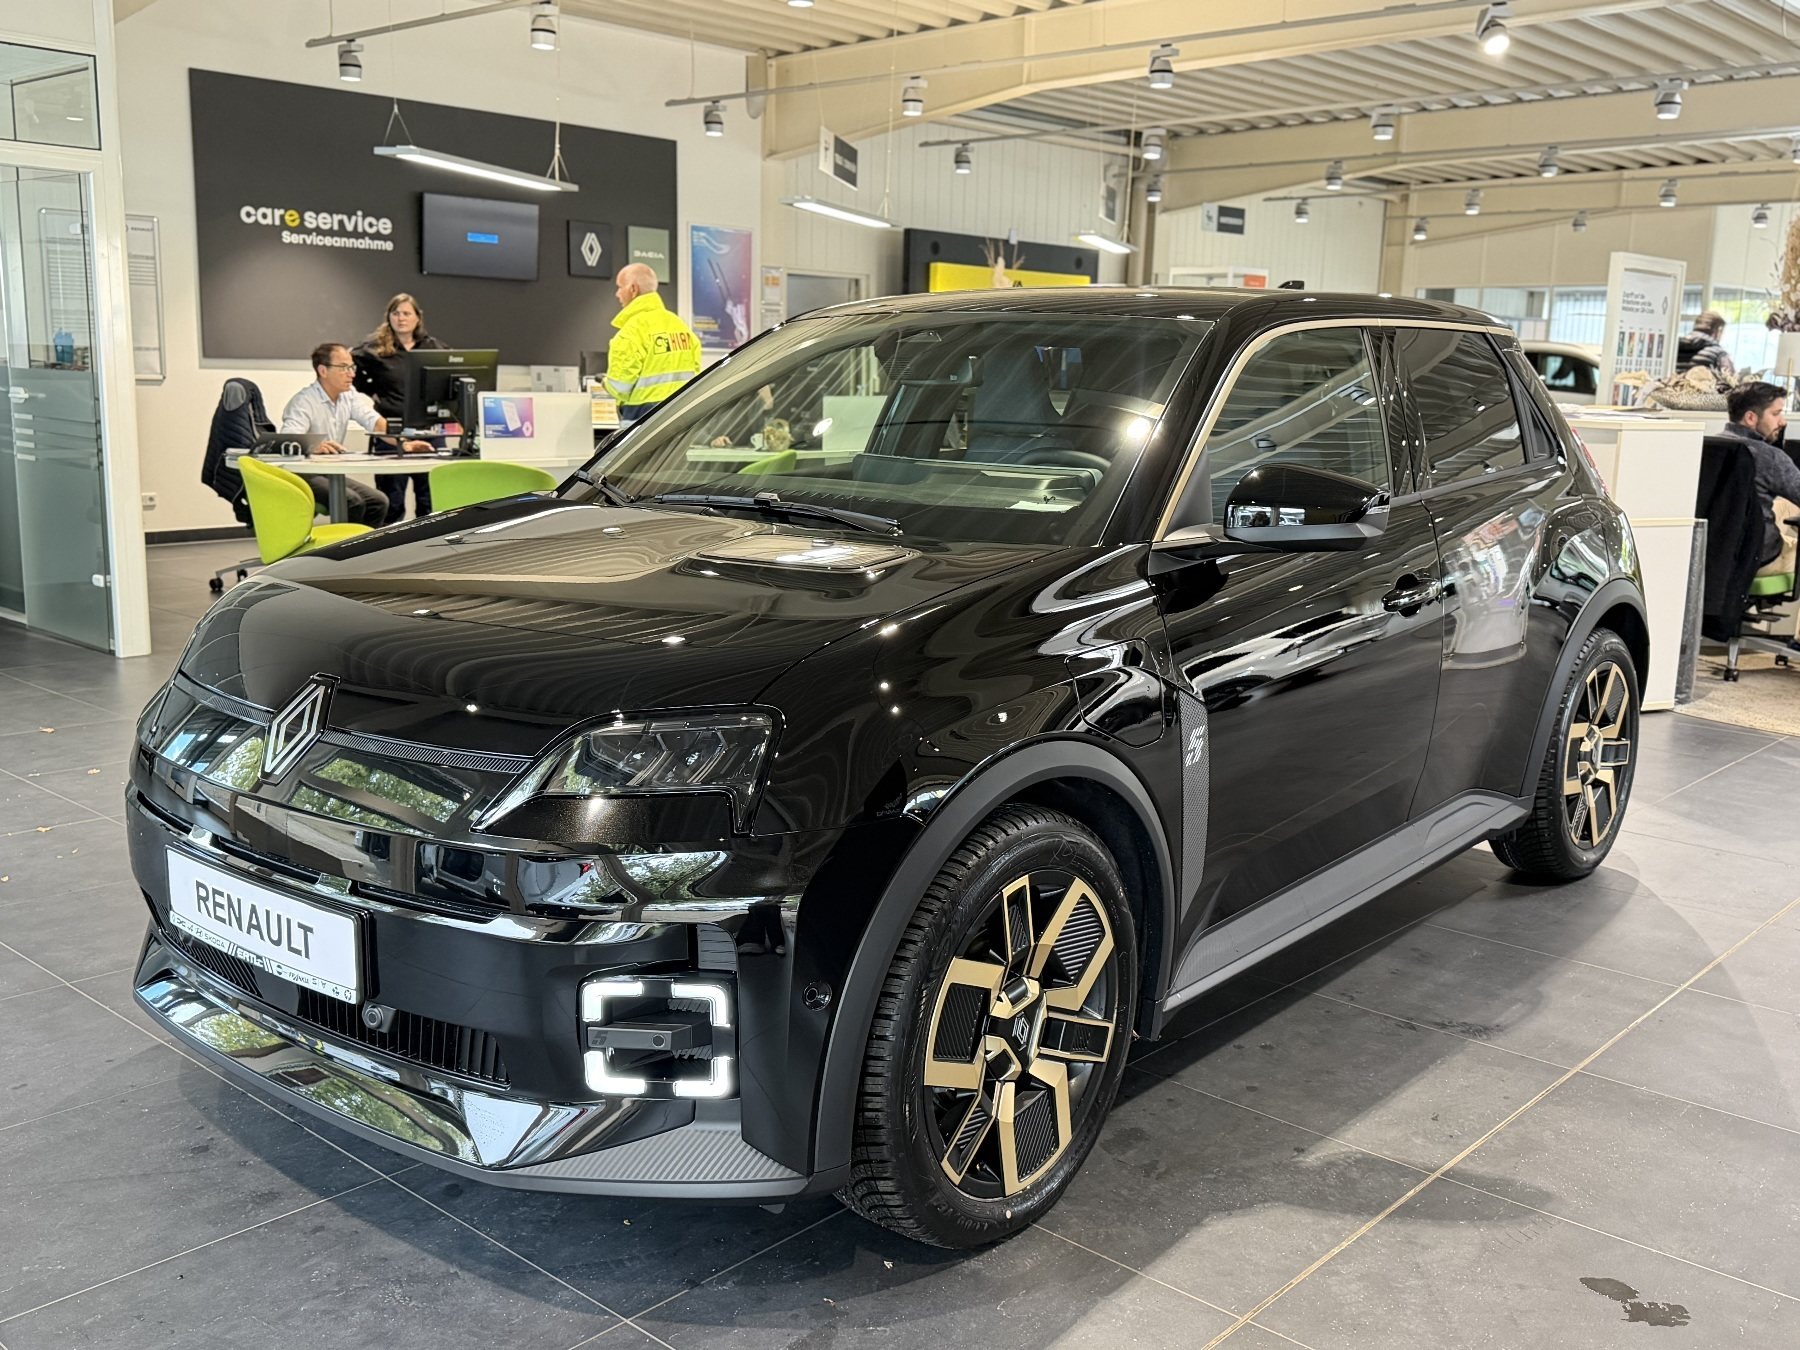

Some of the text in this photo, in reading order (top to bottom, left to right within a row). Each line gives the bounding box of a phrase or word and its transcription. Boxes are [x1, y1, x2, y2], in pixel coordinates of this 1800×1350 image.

[240, 205, 392, 235] care service
[281, 230, 394, 251] Serviceannahme
[195, 880, 314, 960] RENAULT
